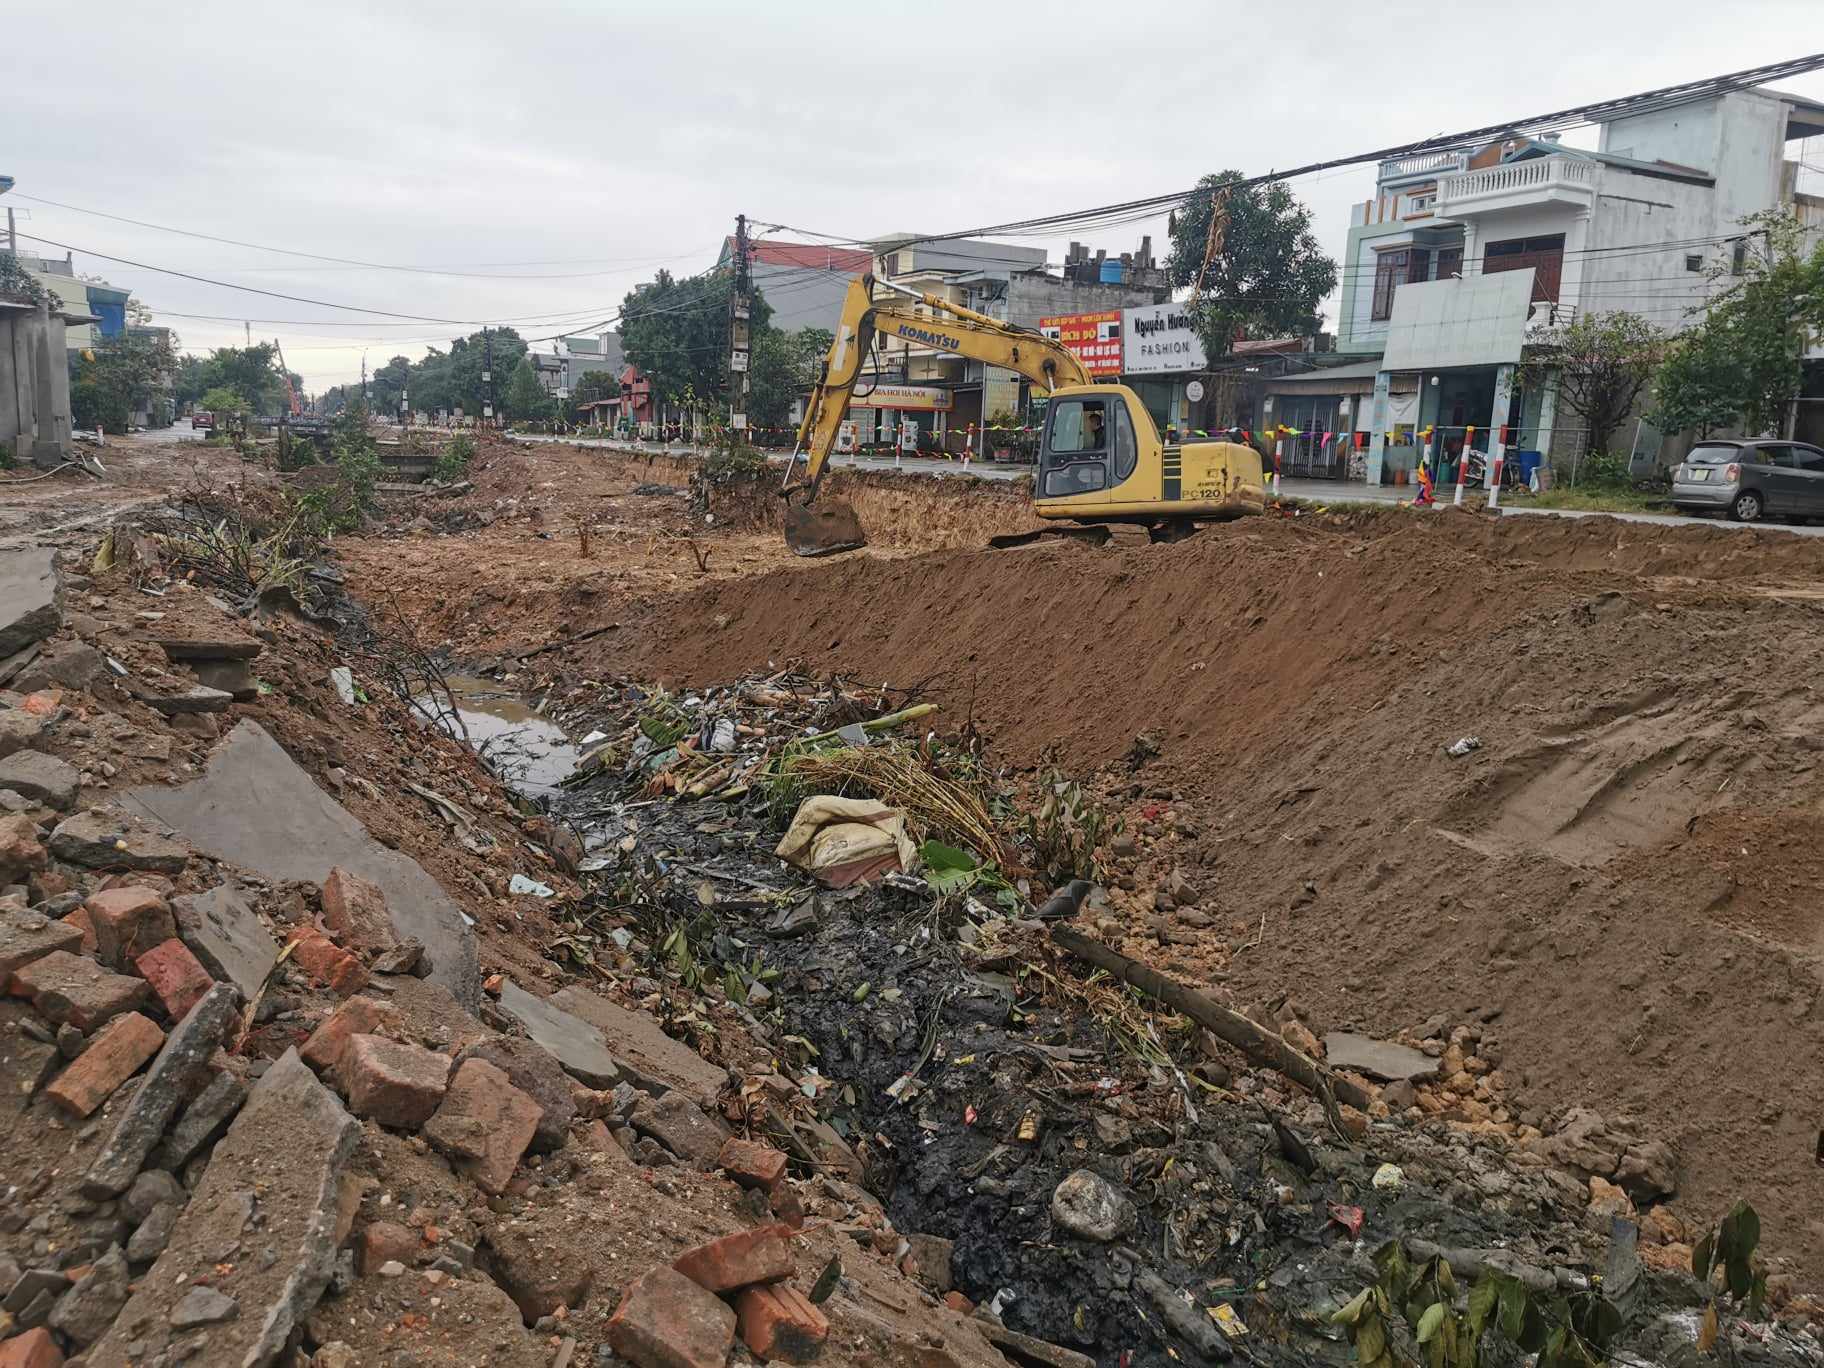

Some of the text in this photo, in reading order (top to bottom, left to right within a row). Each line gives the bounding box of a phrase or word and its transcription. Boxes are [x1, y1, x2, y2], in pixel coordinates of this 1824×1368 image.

[1134, 311, 1165, 337] Nguyễn
[898, 324, 960, 350] KOMATSU
[1141, 341, 1191, 356] FASHION
[1183, 489, 1221, 498] PC120
